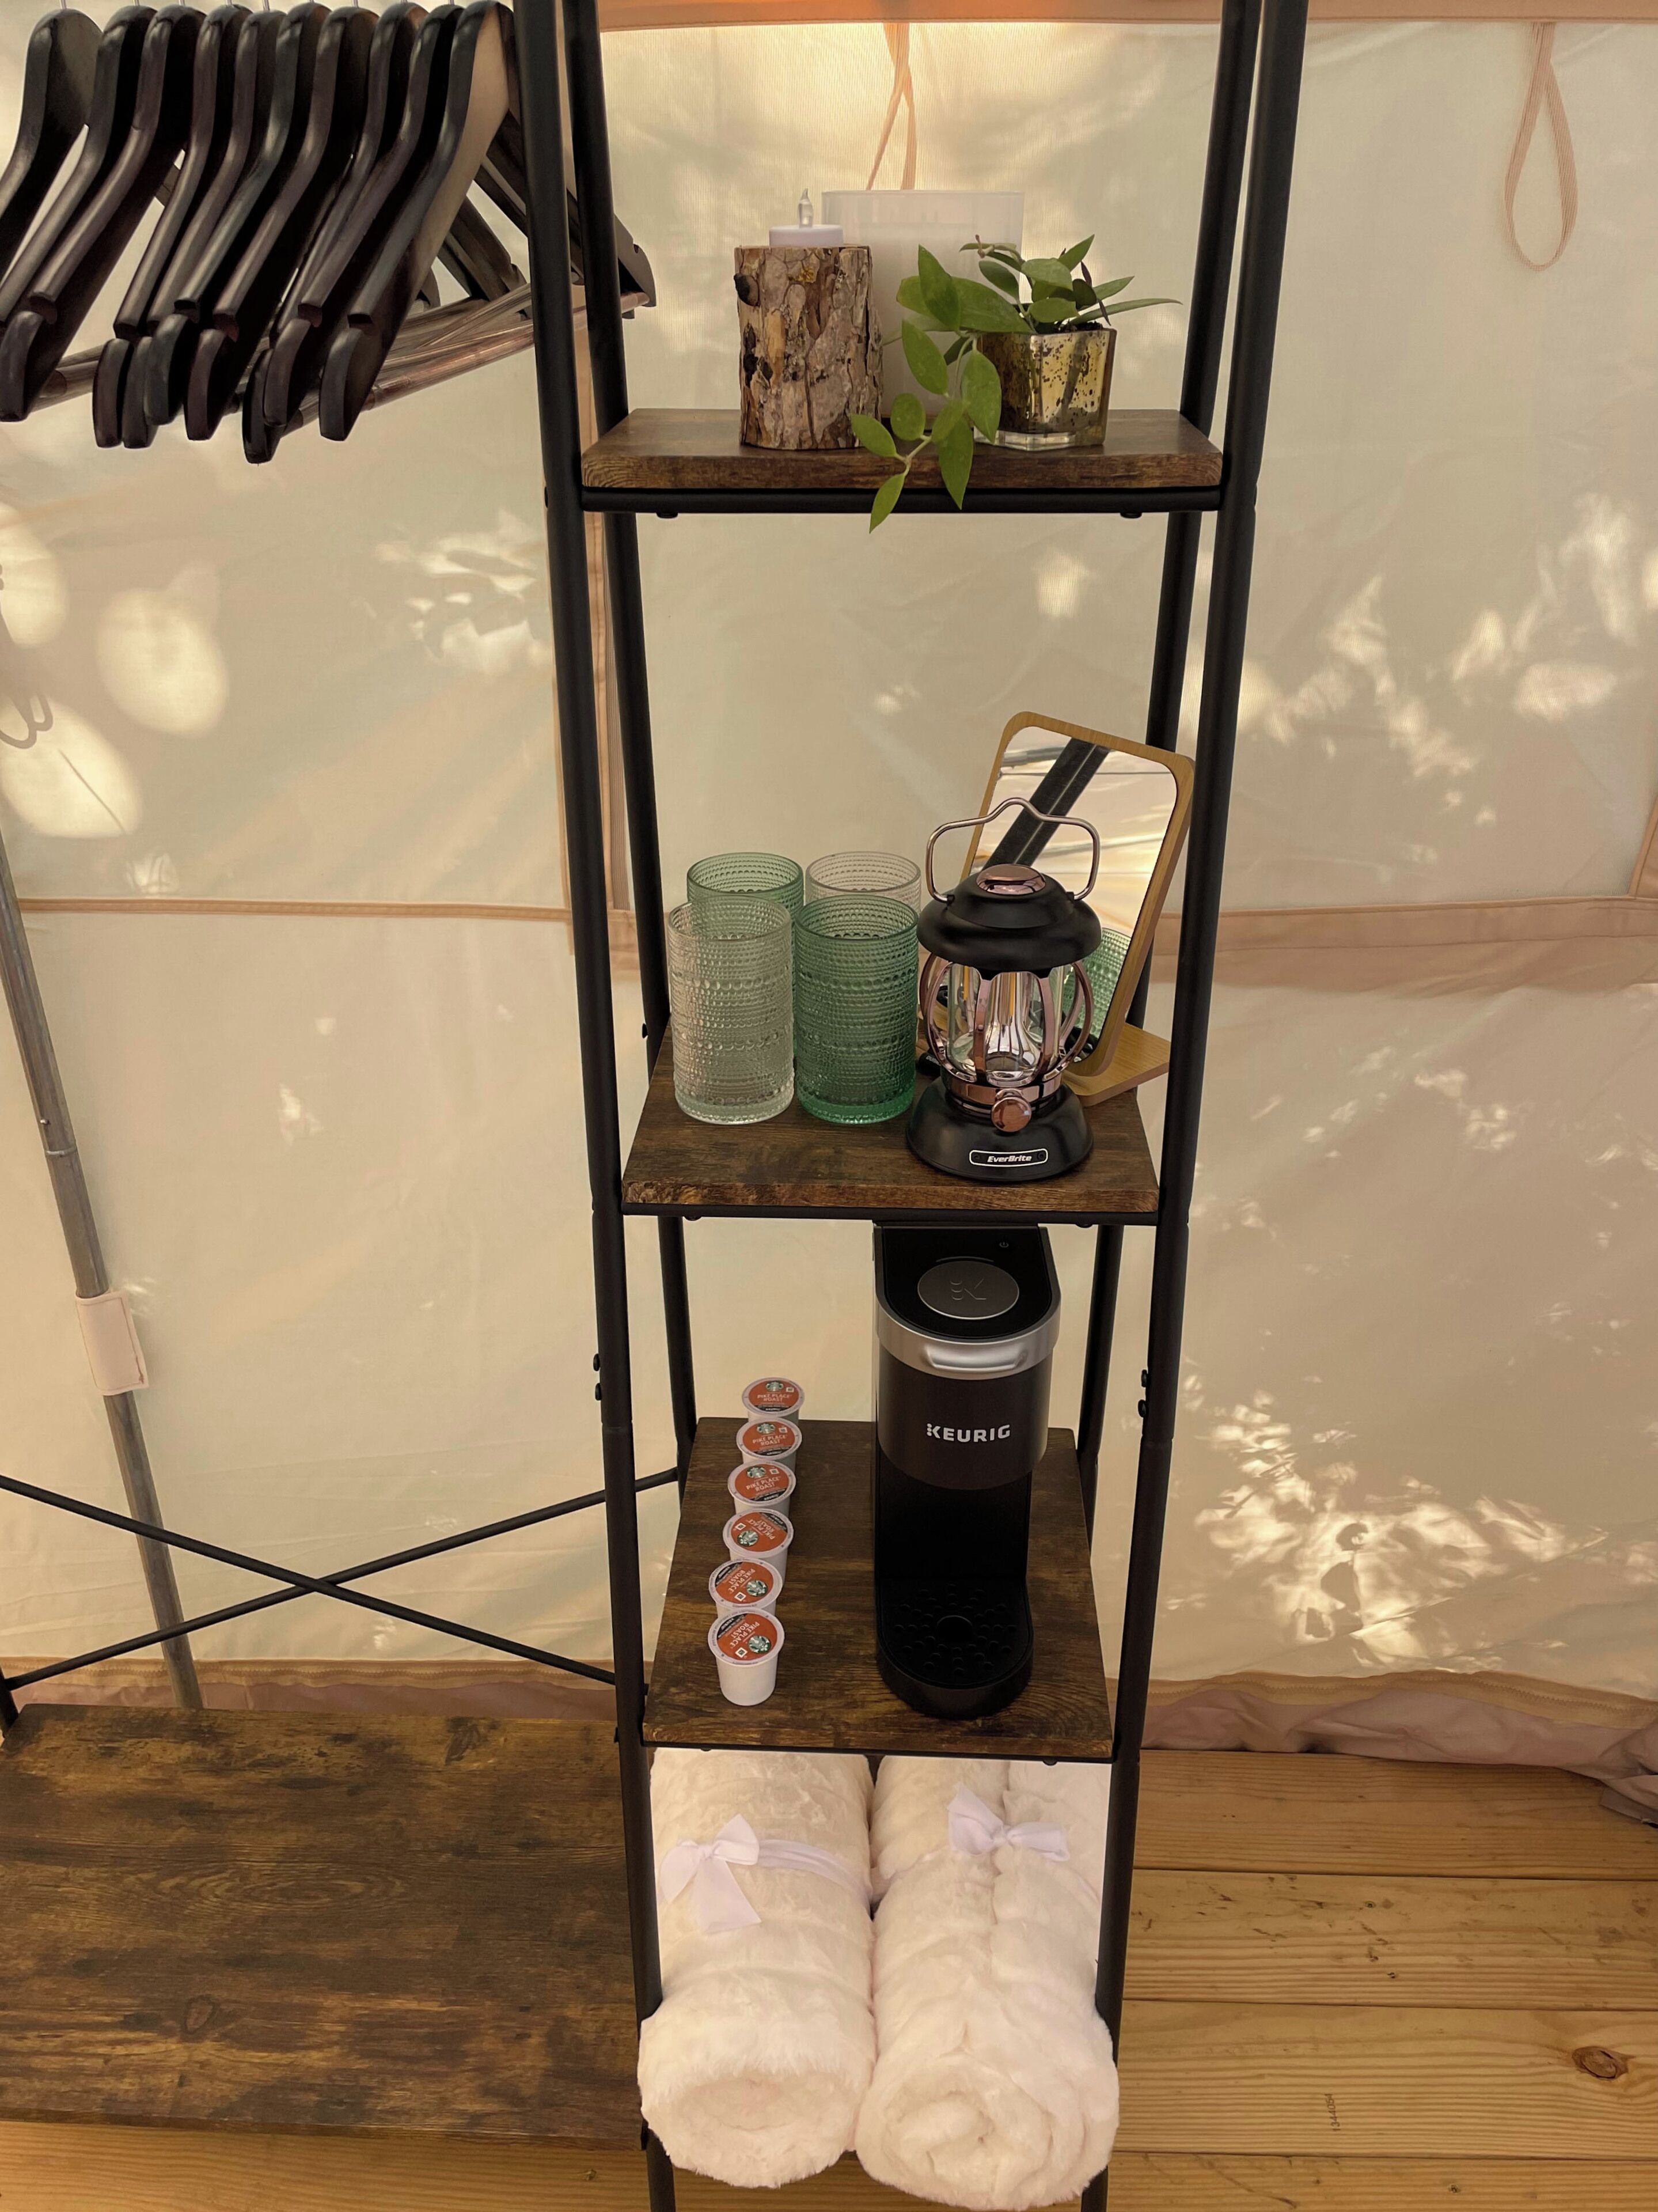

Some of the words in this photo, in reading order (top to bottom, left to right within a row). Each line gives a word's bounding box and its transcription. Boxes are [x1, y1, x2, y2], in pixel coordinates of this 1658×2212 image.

[926, 1423, 1010, 1442] KEURIG
[754, 1482, 775, 1492] ROAST
[728, 1577, 745, 1593] PLACE
[729, 1570, 746, 1585] ROAST
[731, 1622, 750, 1639] ROAST
[746, 1622, 760, 1633] PIKE
[730, 1631, 748, 1647] PLACE
